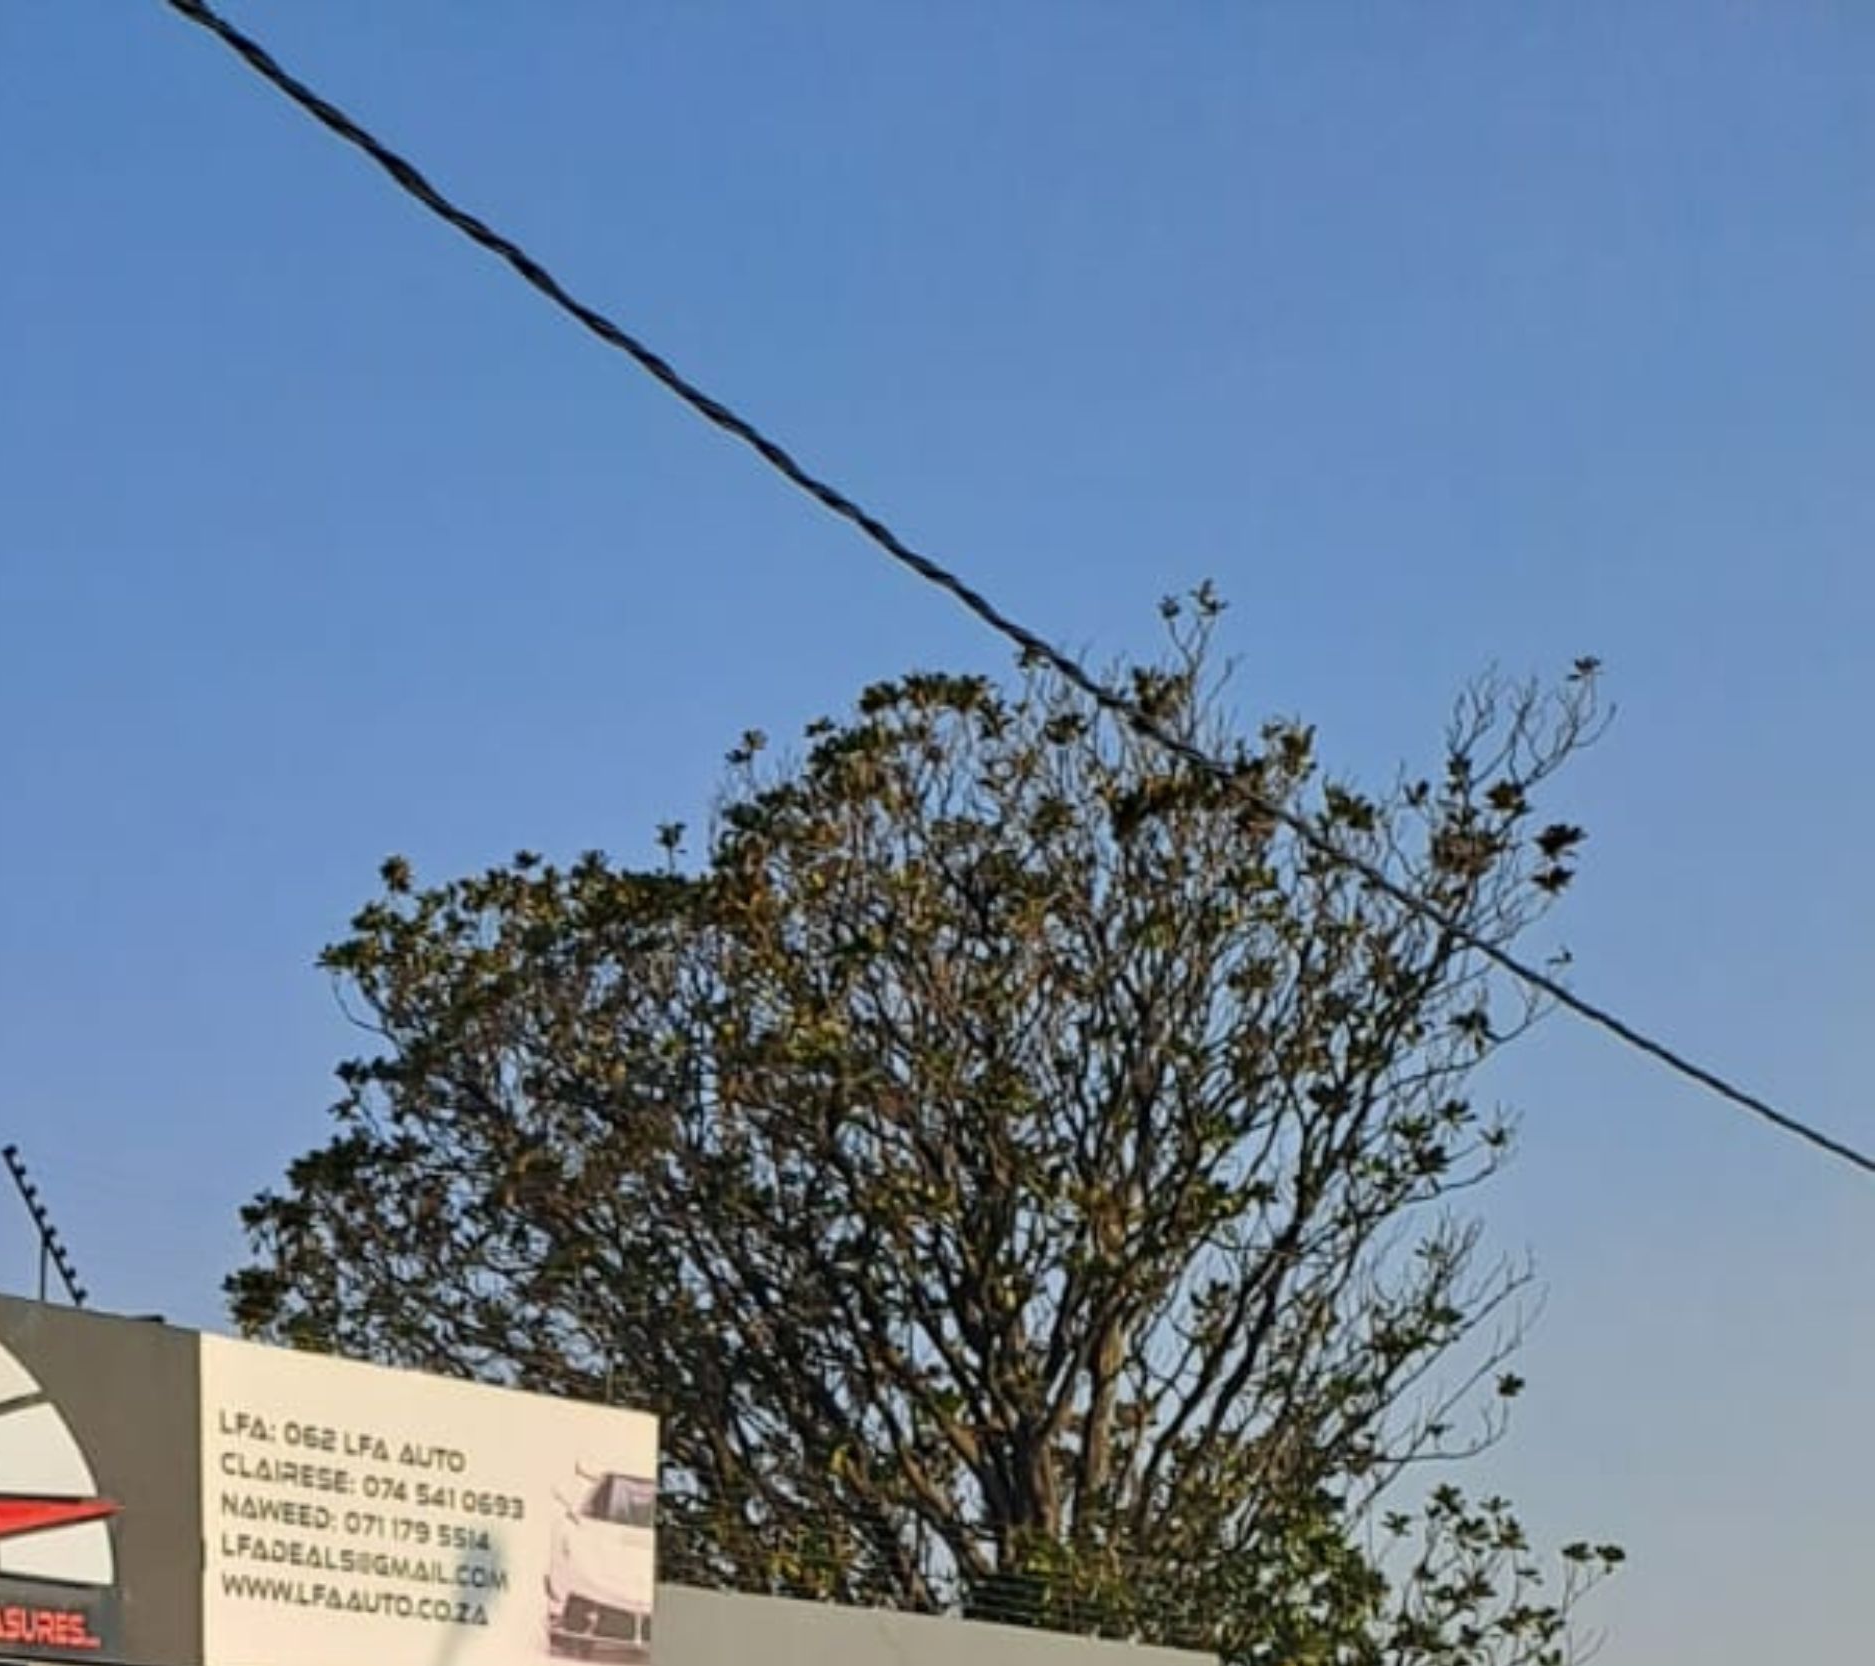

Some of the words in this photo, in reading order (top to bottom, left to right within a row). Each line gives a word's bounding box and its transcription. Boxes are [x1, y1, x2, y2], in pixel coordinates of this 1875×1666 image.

[218, 1409, 277, 1442] LFA:
[282, 1420, 337, 1452] 062
[343, 1430, 391, 1462] LFA
[398, 1442, 467, 1474] AUTO
[362, 1474, 408, 1502] 074
[343, 1510, 386, 1540] 071
